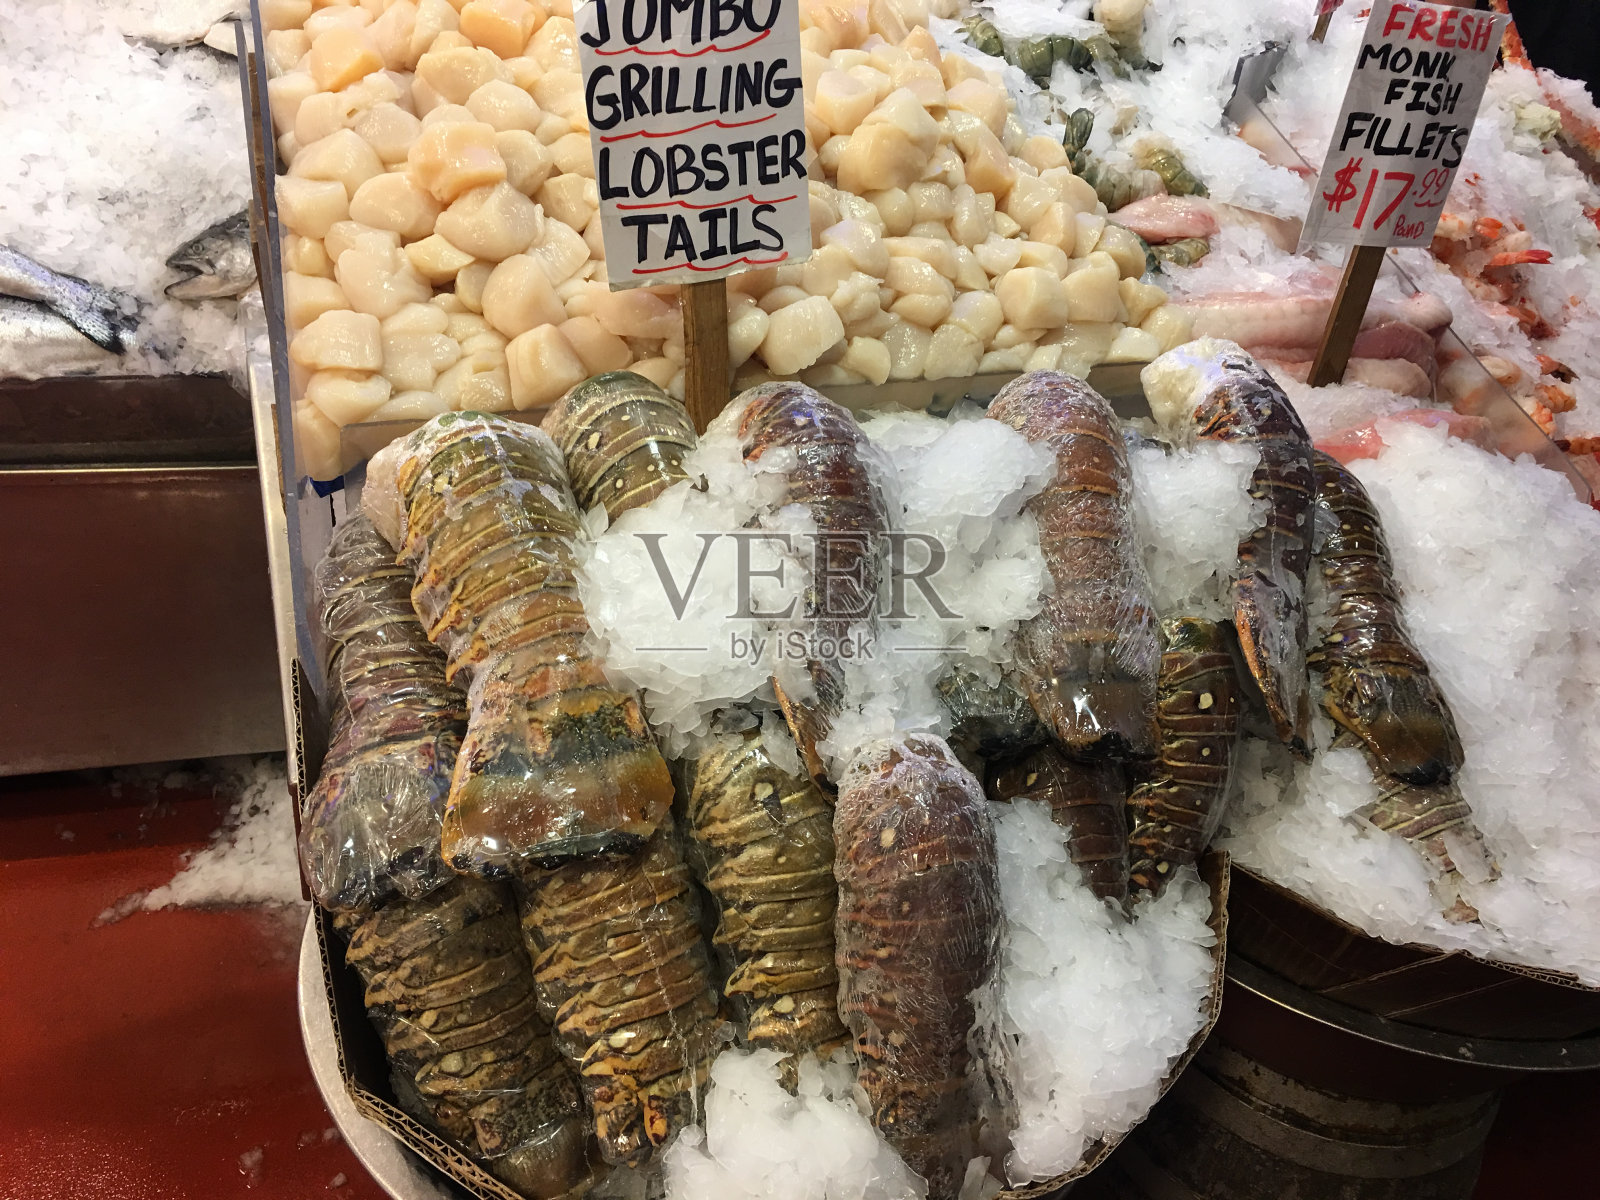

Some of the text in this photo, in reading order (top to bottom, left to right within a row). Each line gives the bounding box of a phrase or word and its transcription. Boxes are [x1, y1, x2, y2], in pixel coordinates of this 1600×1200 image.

[1382, 3, 1494, 53] FRESH
[1357, 43, 1456, 82] MONK
[585, 59, 803, 130] GRILLING
[1384, 78, 1463, 116] FISH
[599, 129, 808, 200] LOBSTER
[1339, 112, 1469, 169] FILLETS
[621, 204, 784, 264] TAILS
